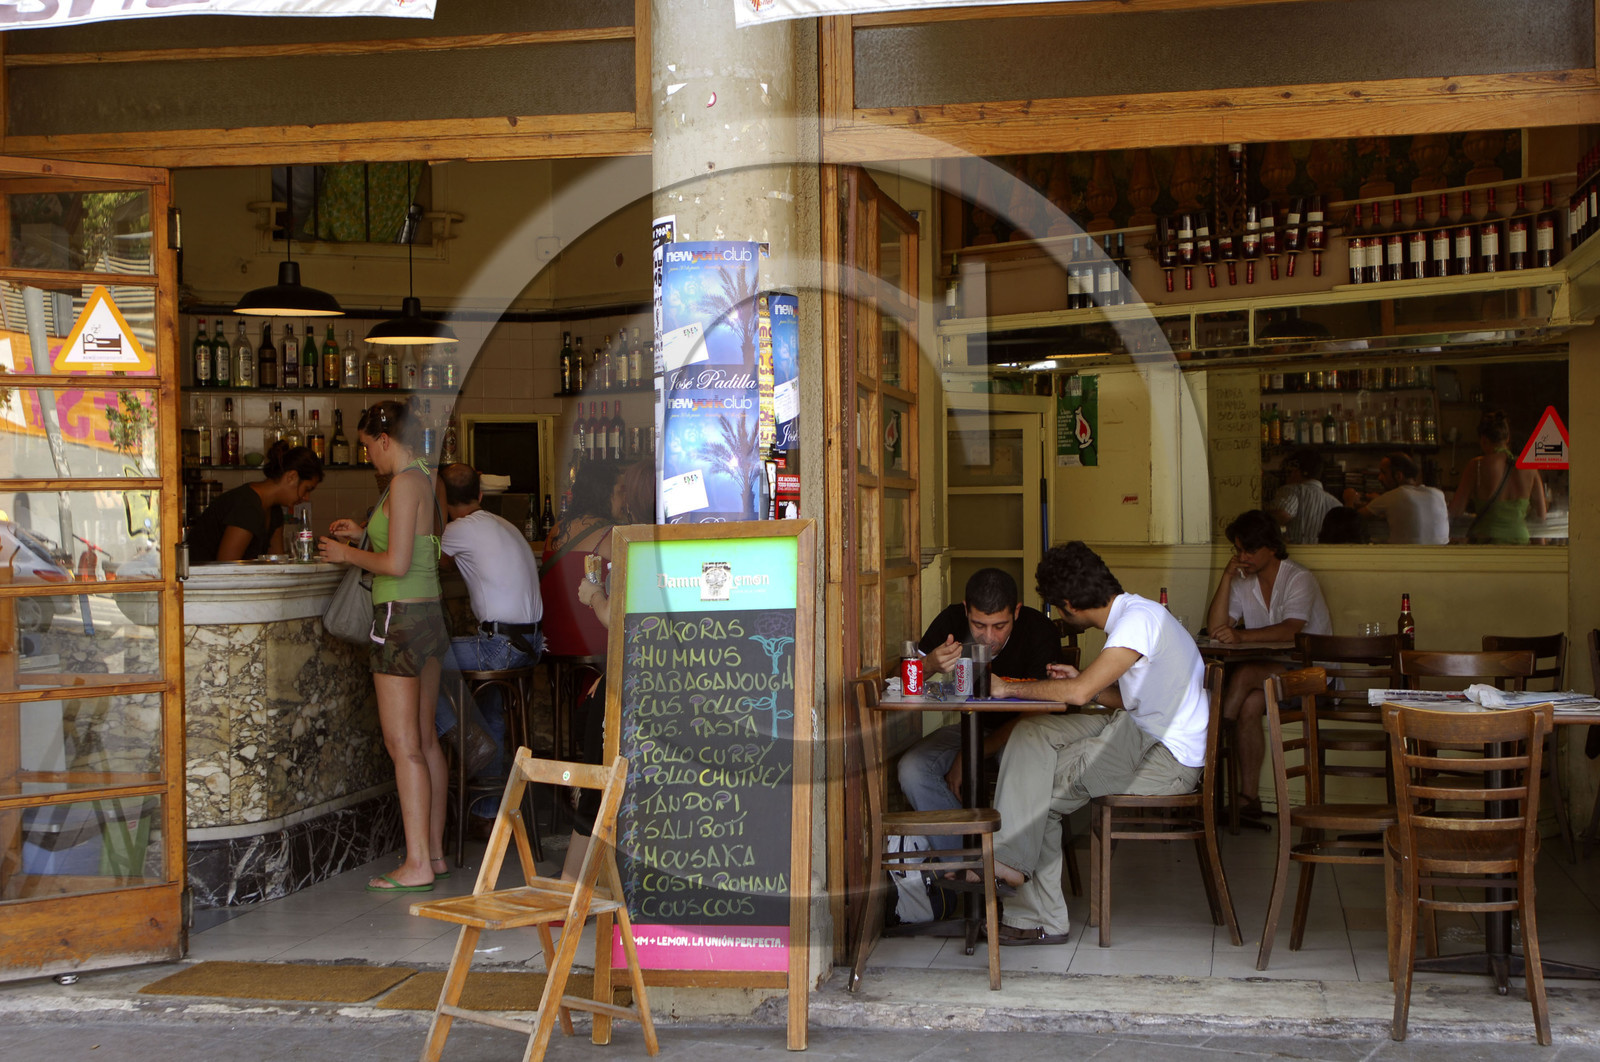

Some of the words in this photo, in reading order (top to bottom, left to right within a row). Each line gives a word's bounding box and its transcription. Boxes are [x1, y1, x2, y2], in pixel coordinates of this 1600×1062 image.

[666, 247, 752, 264] newyorkclub
[670, 370, 693, 390] José
[696, 369, 757, 389] Padilla
[667, 395, 752, 411] newyorkclub
[641, 616, 745, 643] PAKORAS
[640, 646, 742, 669] HUMMUS
[640, 655, 794, 693] BABAGANOUGH
[689, 694, 753, 715] POLLO
[690, 714, 759, 739] PASTA
[640, 741, 694, 764] POLLO
[699, 741, 776, 766] CURRY
[641, 765, 698, 786] POLLO
[699, 762, 792, 789] CHUTNEY
[643, 844, 756, 870] MOUSAKA
[712, 871, 789, 894] ROMANA
[641, 896, 756, 918] COUSCOUS
[656, 937, 691, 947] LEMON.
[692, 937, 704, 947] LA
[705, 935, 734, 947] UNIÓN
[734, 937, 785, 948] PERFECTA.
